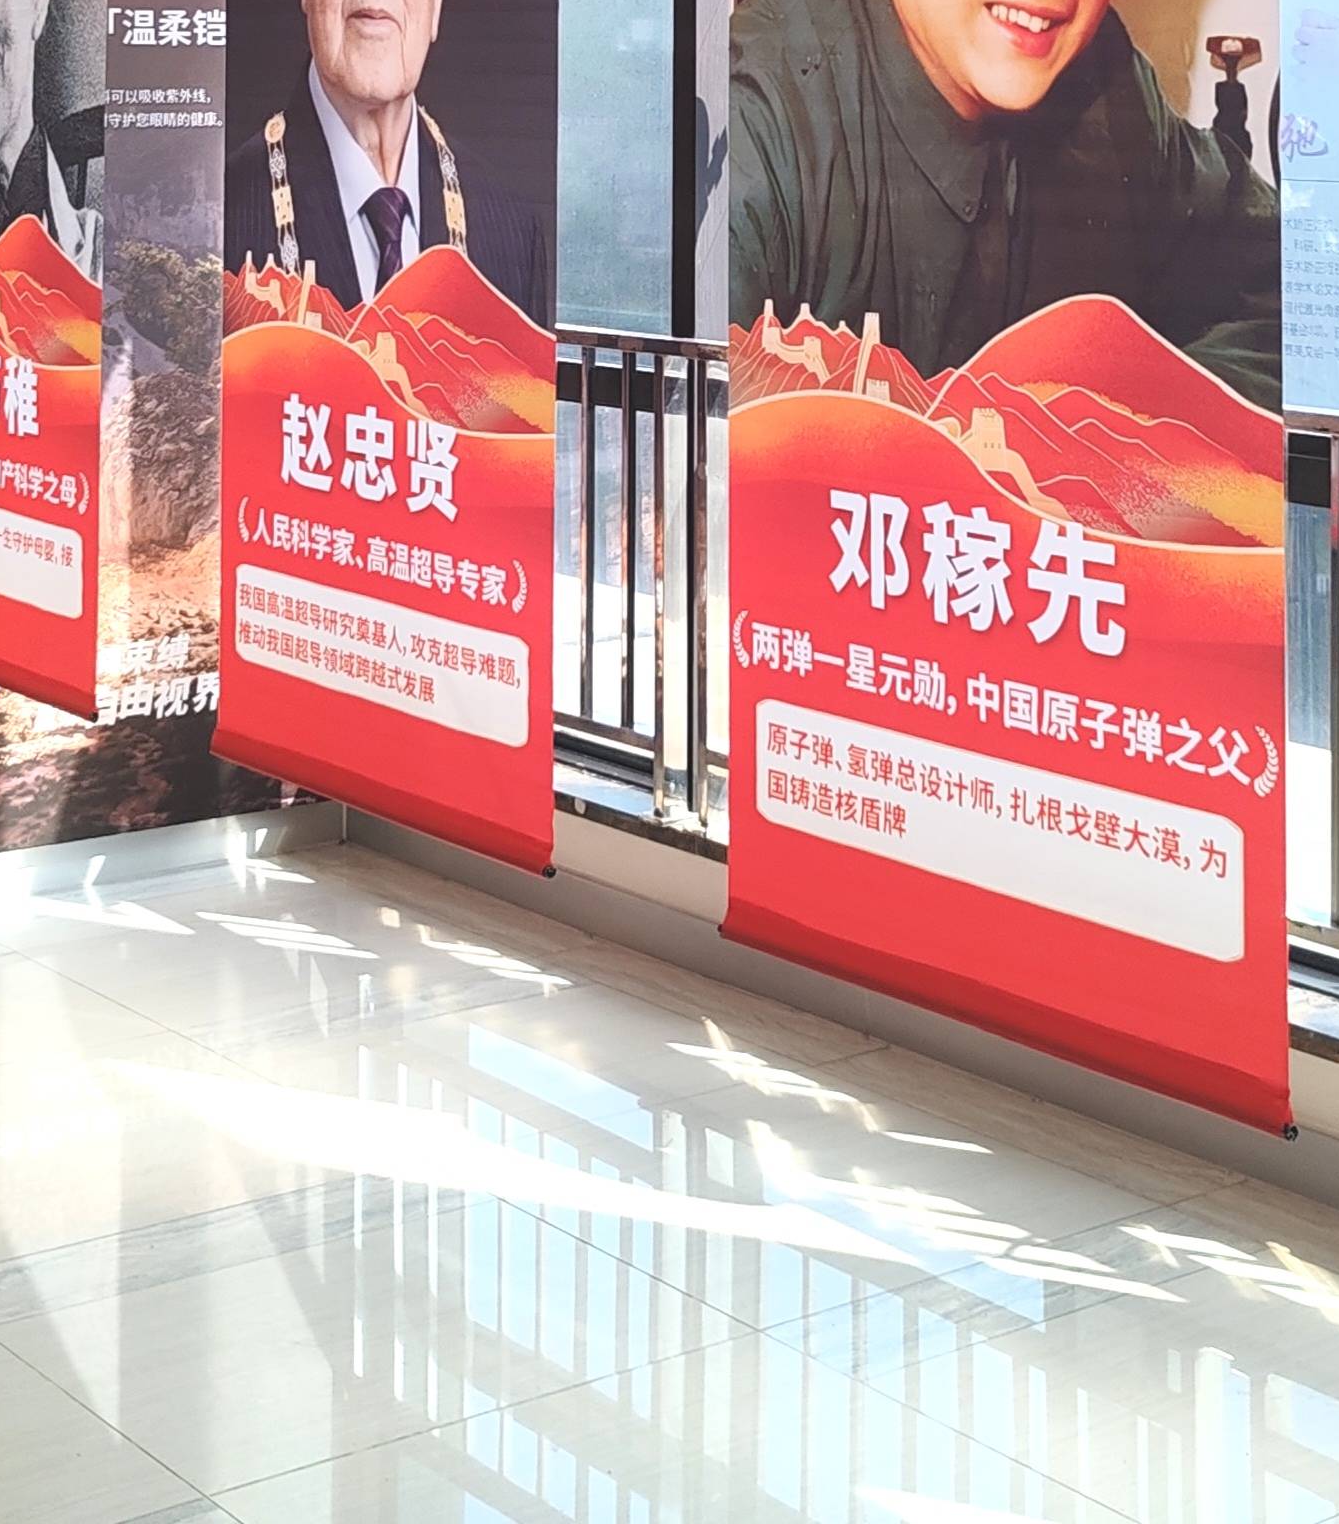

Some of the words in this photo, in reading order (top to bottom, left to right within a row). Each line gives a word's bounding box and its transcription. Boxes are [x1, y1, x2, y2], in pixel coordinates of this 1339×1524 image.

[104, 111, 224, 129] 守护您眼睛的健康。
[105, 88, 211, 105] 可以吸收紫外线，
[280, 393, 460, 522] 赵忠贤
[828, 488, 1127, 657] 邓稼先
[238, 618, 436, 704] 推动我国超导领域跨越式发展
[766, 770, 908, 839] 国铸造核盾牌
